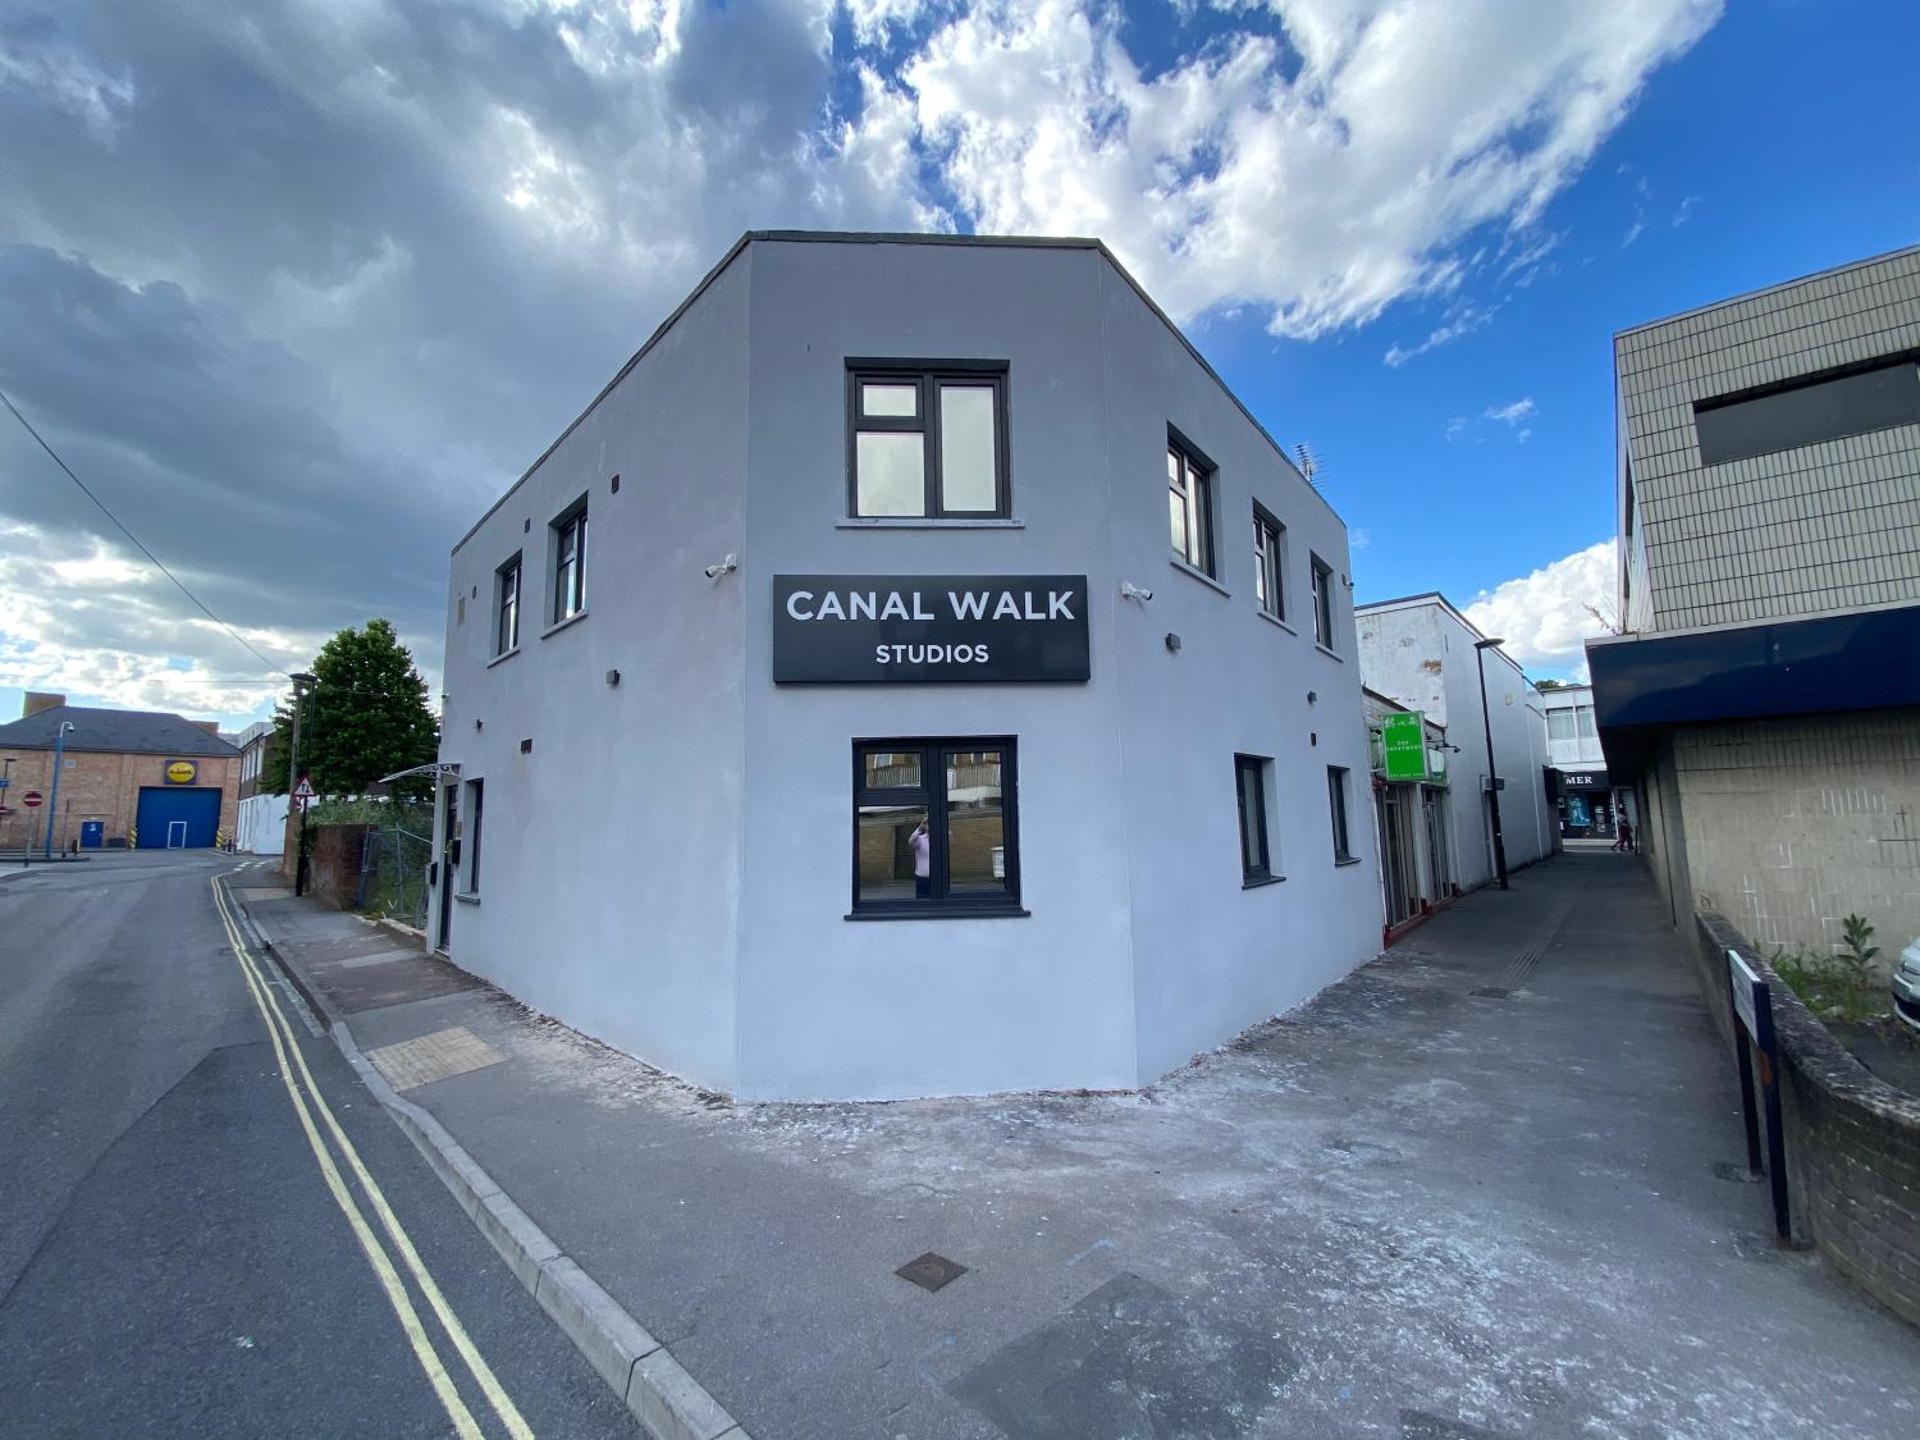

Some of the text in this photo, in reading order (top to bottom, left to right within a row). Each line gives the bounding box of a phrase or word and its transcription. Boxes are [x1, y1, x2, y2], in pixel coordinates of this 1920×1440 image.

[786, 590, 1075, 621] CANAL WALK
[876, 644, 989, 664] STUDIOS
